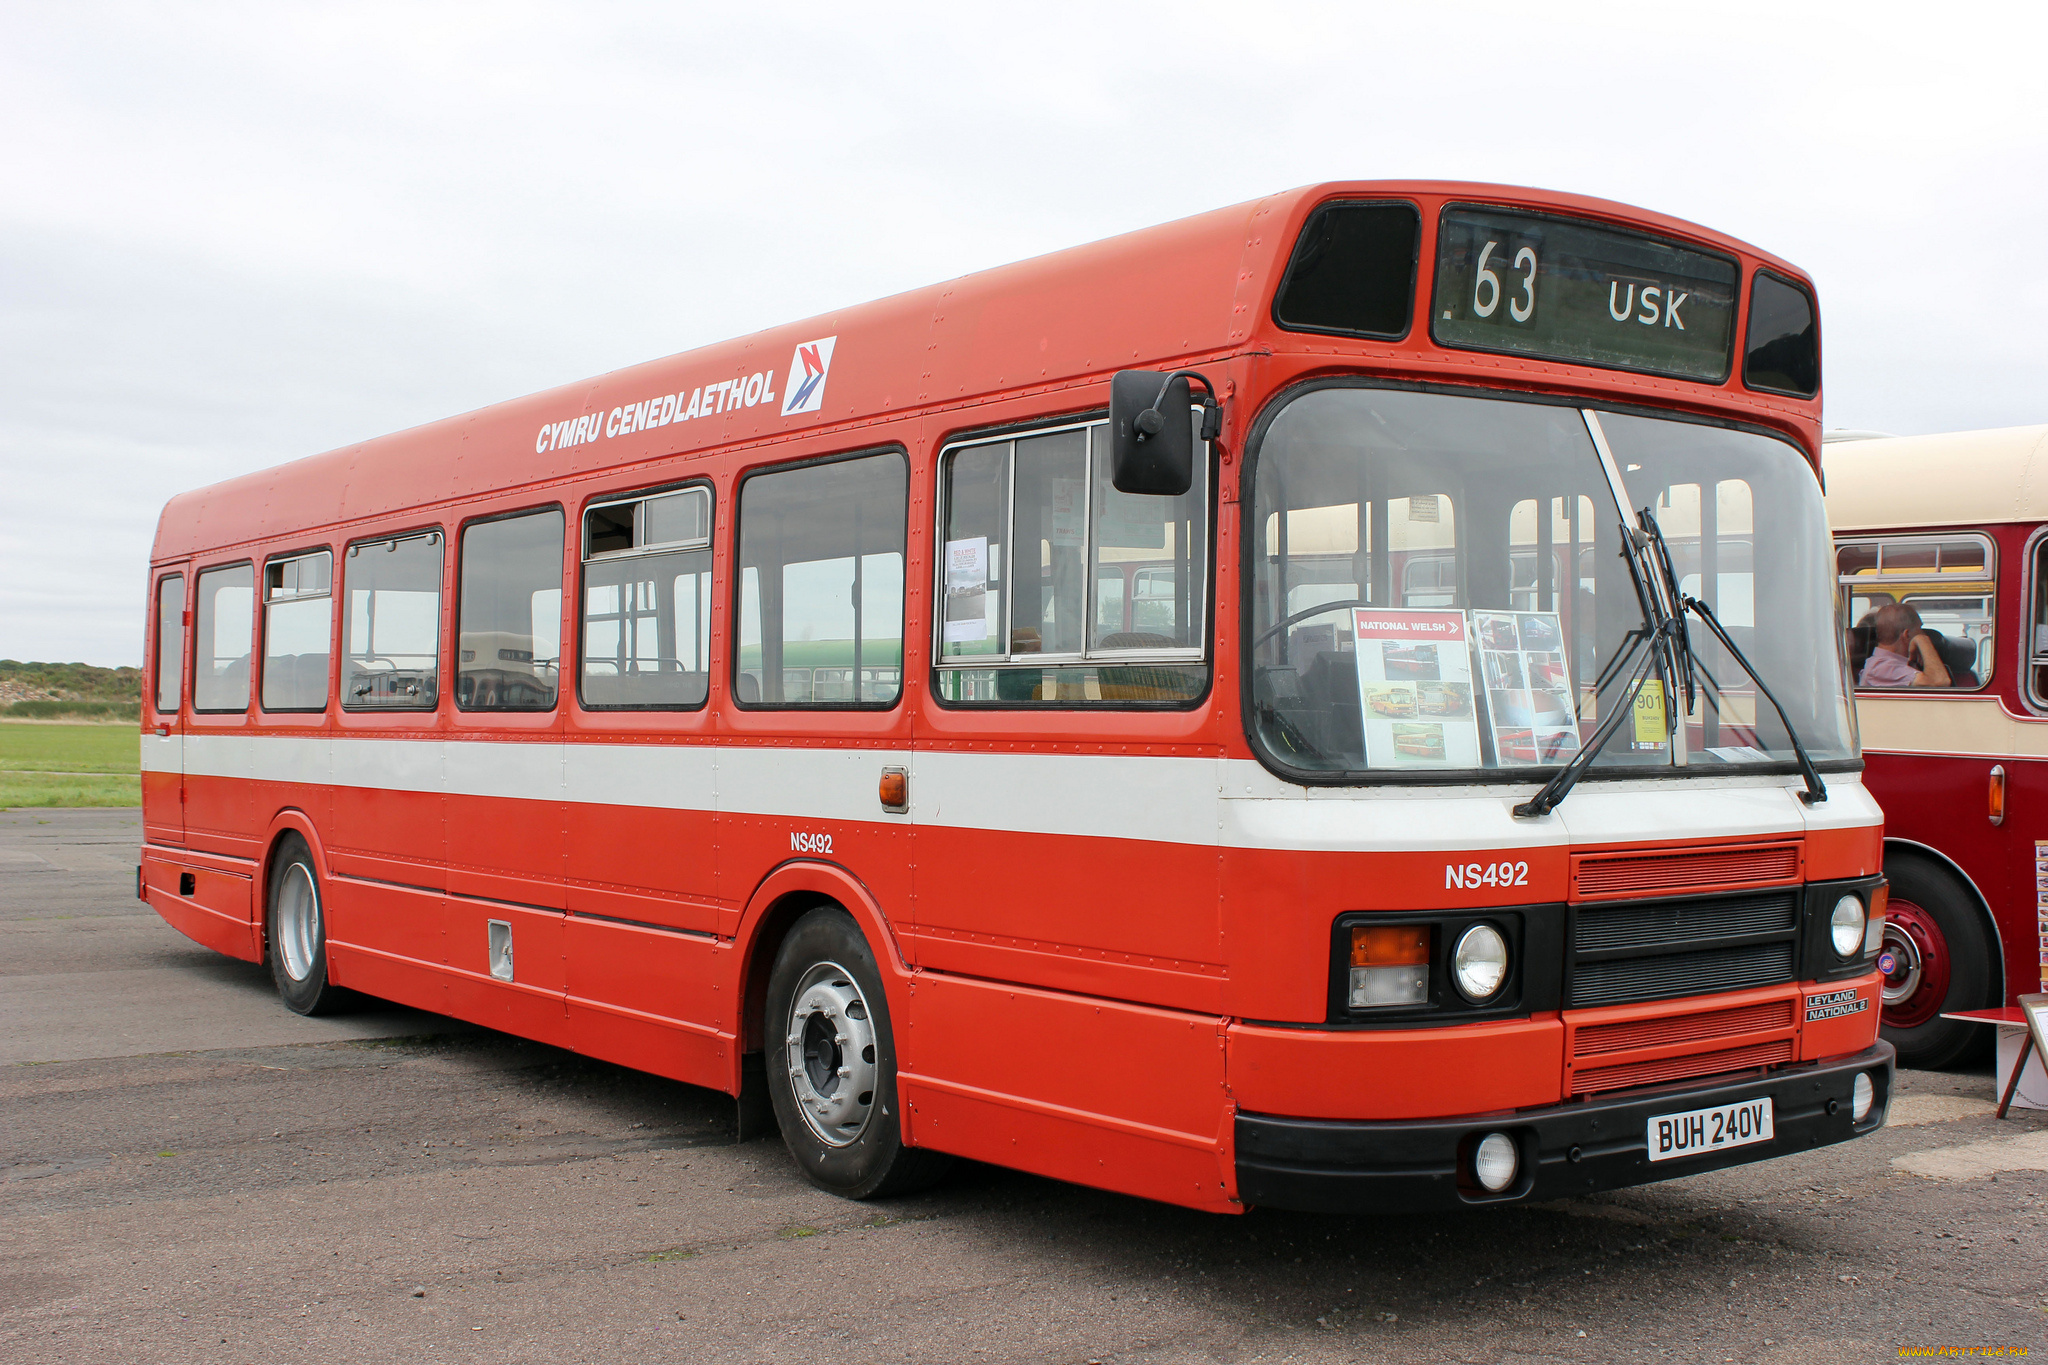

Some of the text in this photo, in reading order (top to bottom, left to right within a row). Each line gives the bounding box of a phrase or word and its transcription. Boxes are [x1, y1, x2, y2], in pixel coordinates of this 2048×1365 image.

[1473, 241, 1537, 322] 63
[1609, 281, 1688, 331] USK
[535, 370, 775, 454] CYMRU CENEDLAETHOL
[1360, 621, 1446, 632] NATIONAL WELSH
[1637, 694, 1661, 709] 901
[791, 832, 833, 854] NS492
[1445, 861, 1528, 890] NS492
[1808, 990, 1855, 1007] LEYLAND
[1809, 1000, 1867, 1020] NATIONAL 2
[1658, 1104, 1763, 1153] BUH 240V
